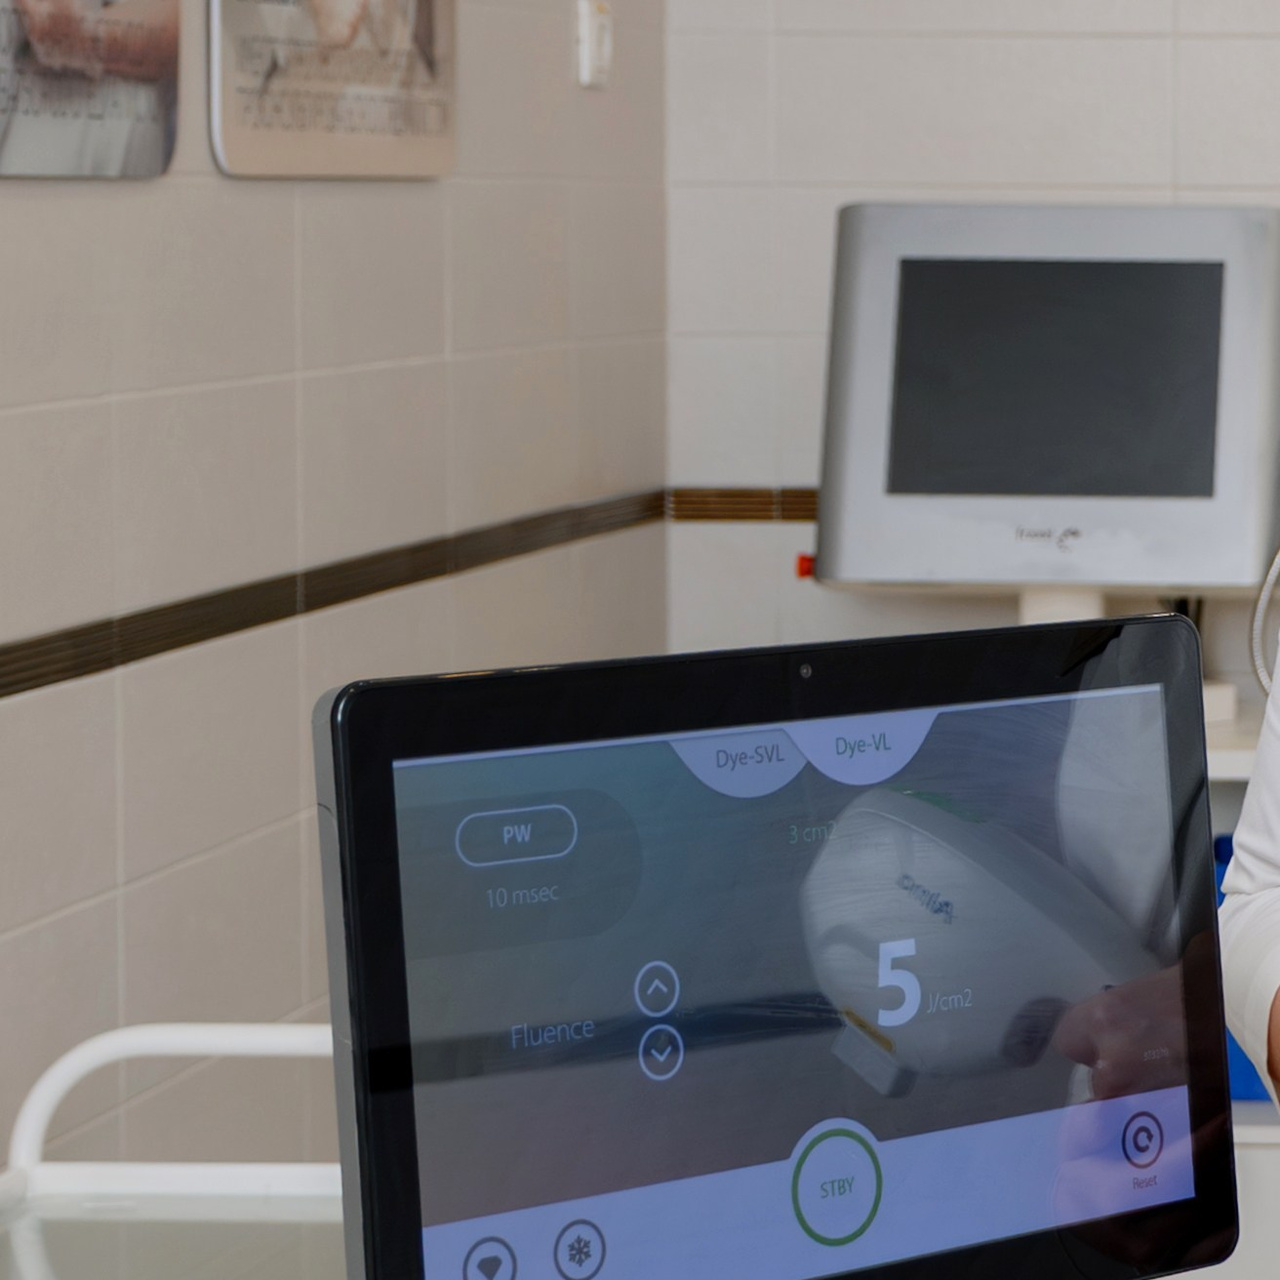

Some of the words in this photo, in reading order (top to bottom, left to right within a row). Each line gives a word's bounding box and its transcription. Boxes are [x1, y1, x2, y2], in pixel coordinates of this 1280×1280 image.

[715, 744, 786, 771] Dye-SVL
[835, 732, 892, 759] Dye-VL
[503, 823, 532, 845] PW
[788, 824, 799, 844] 3
[486, 887, 508, 909] 10
[511, 885, 560, 905] msec
[877, 938, 922, 1027] 5
[510, 1020, 595, 1049] Fluence
[820, 1176, 855, 1199] STBY
[1132, 1175, 1158, 1190] Reset
